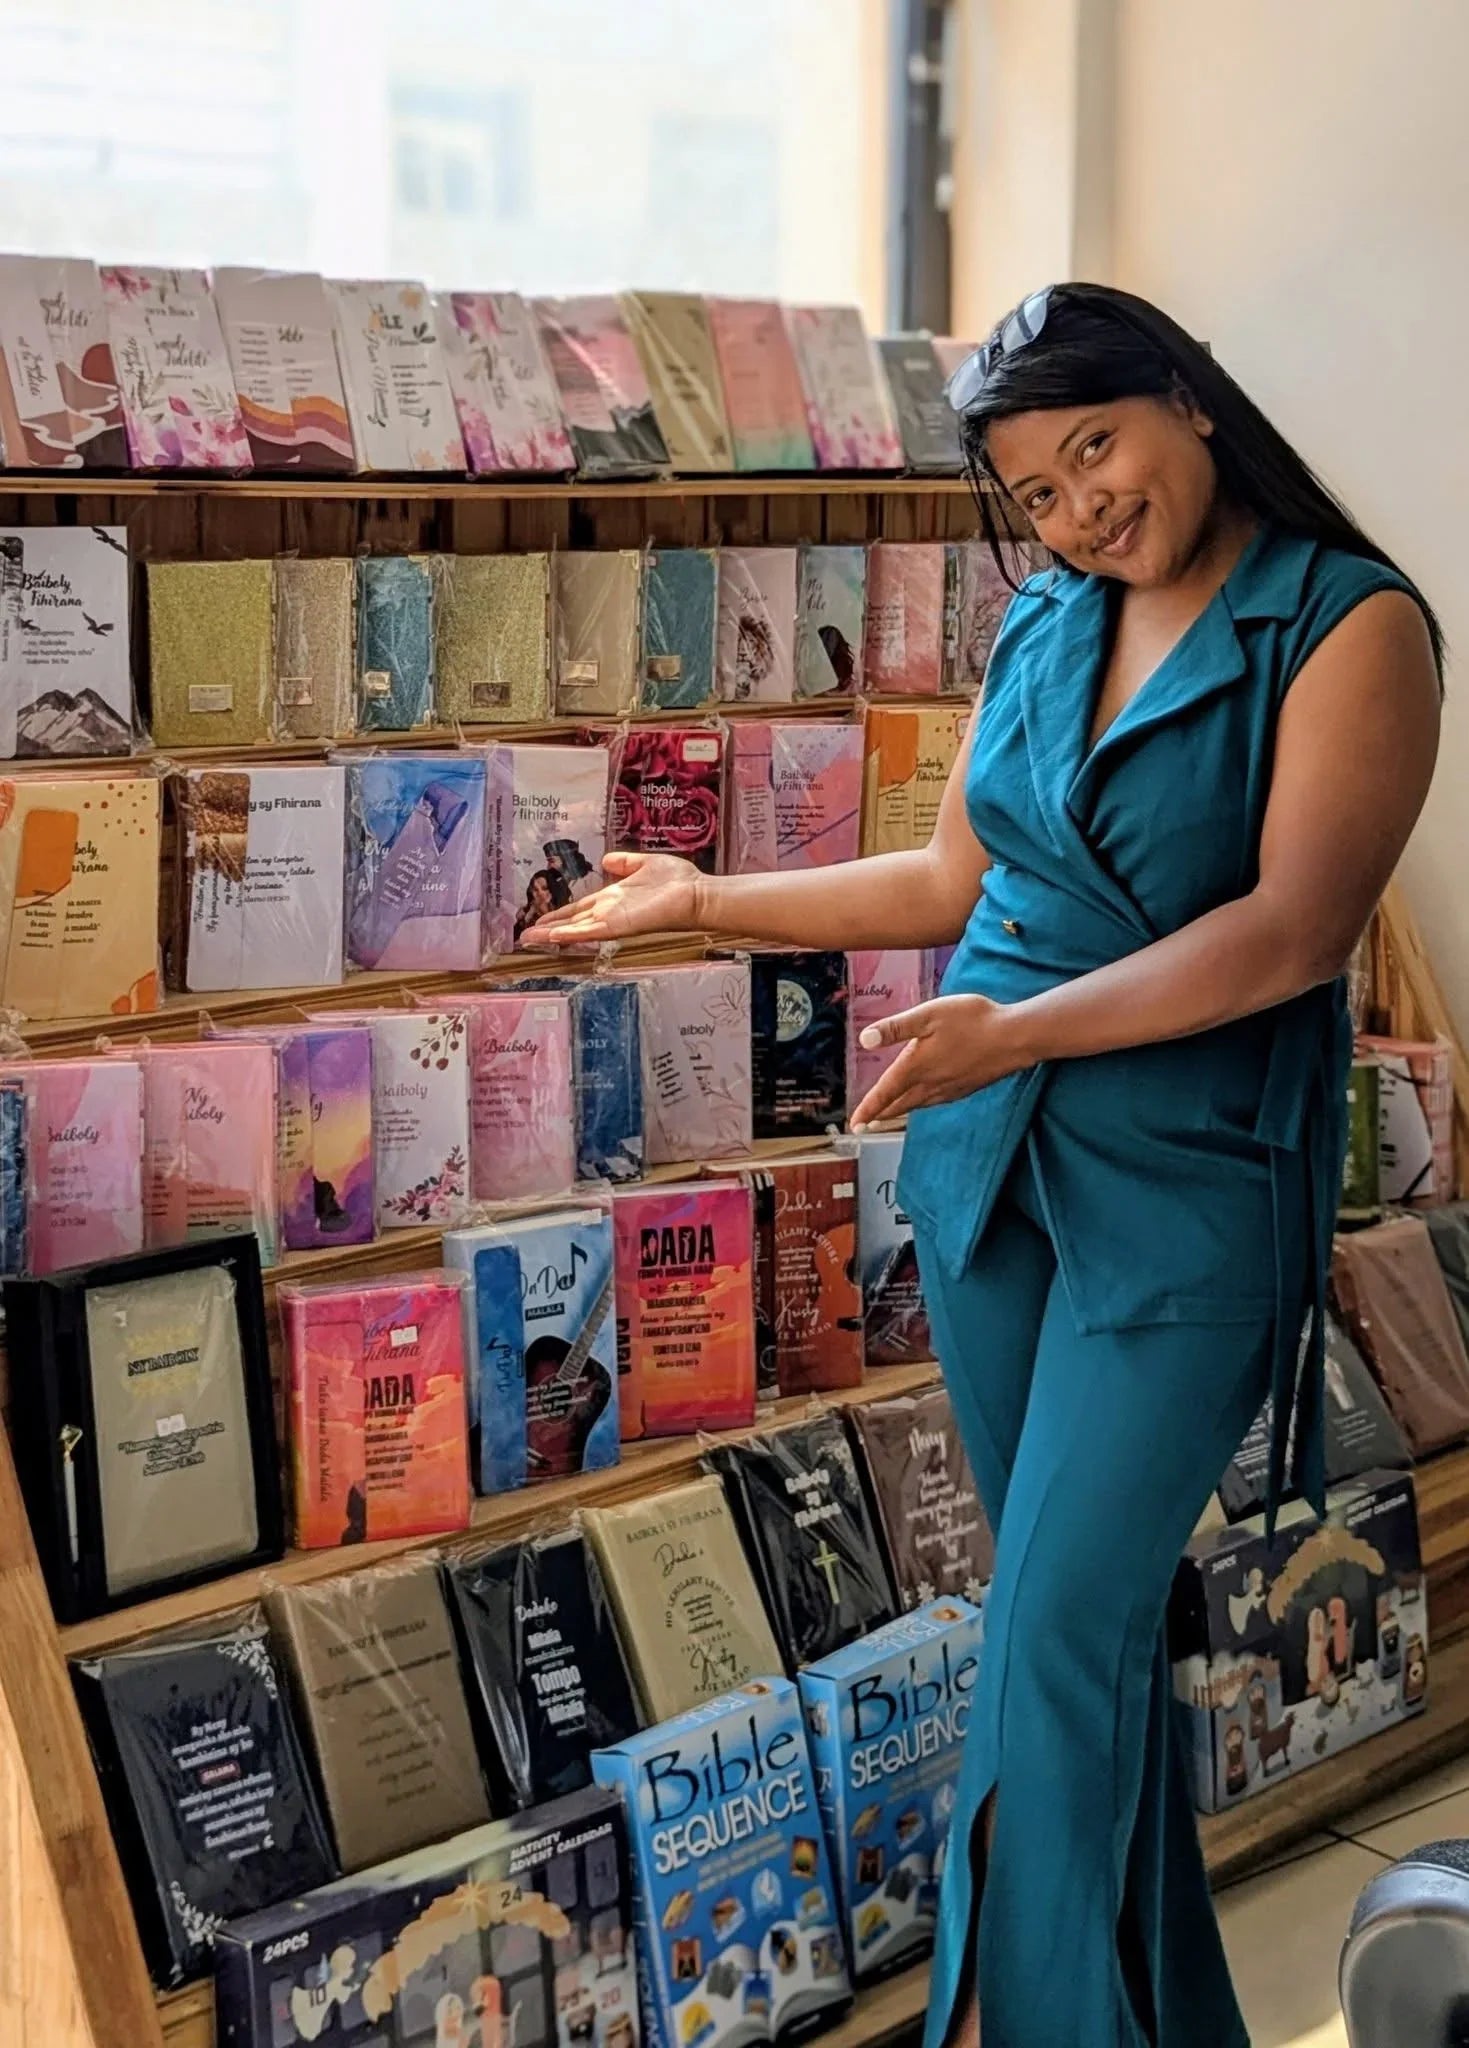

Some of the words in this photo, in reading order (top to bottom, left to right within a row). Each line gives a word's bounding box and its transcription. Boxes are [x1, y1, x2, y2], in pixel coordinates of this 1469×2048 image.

[512, 794, 560, 809] Baiboly
[641, 783, 677, 797] aiboly
[259, 801, 273, 812] sy
[274, 797, 322, 810] Fihirana
[642, 796, 685, 808] ihirana
[74, 840, 99, 861] boly
[680, 1023, 715, 1037] aiboly
[484, 1038, 540, 1057] Baiboly
[185, 1105, 224, 1124] iboly
[641, 1223, 716, 1269] DADA
[531, 1665, 582, 1695] Tompo
[849, 1641, 979, 1745] Bible
[850, 1695, 974, 1790] SEQUENC
[642, 1715, 799, 1825] Bible
[653, 1771, 808, 1875] SEQUENCE
[509, 1847, 554, 1874] ADVENT
[556, 1822, 613, 1855] CALENDAR
[511, 1831, 561, 1861] NATIVITY
[500, 1886, 522, 1909] 24
[263, 1932, 310, 1964] 24PCS
[309, 1987, 327, 2008] 10
